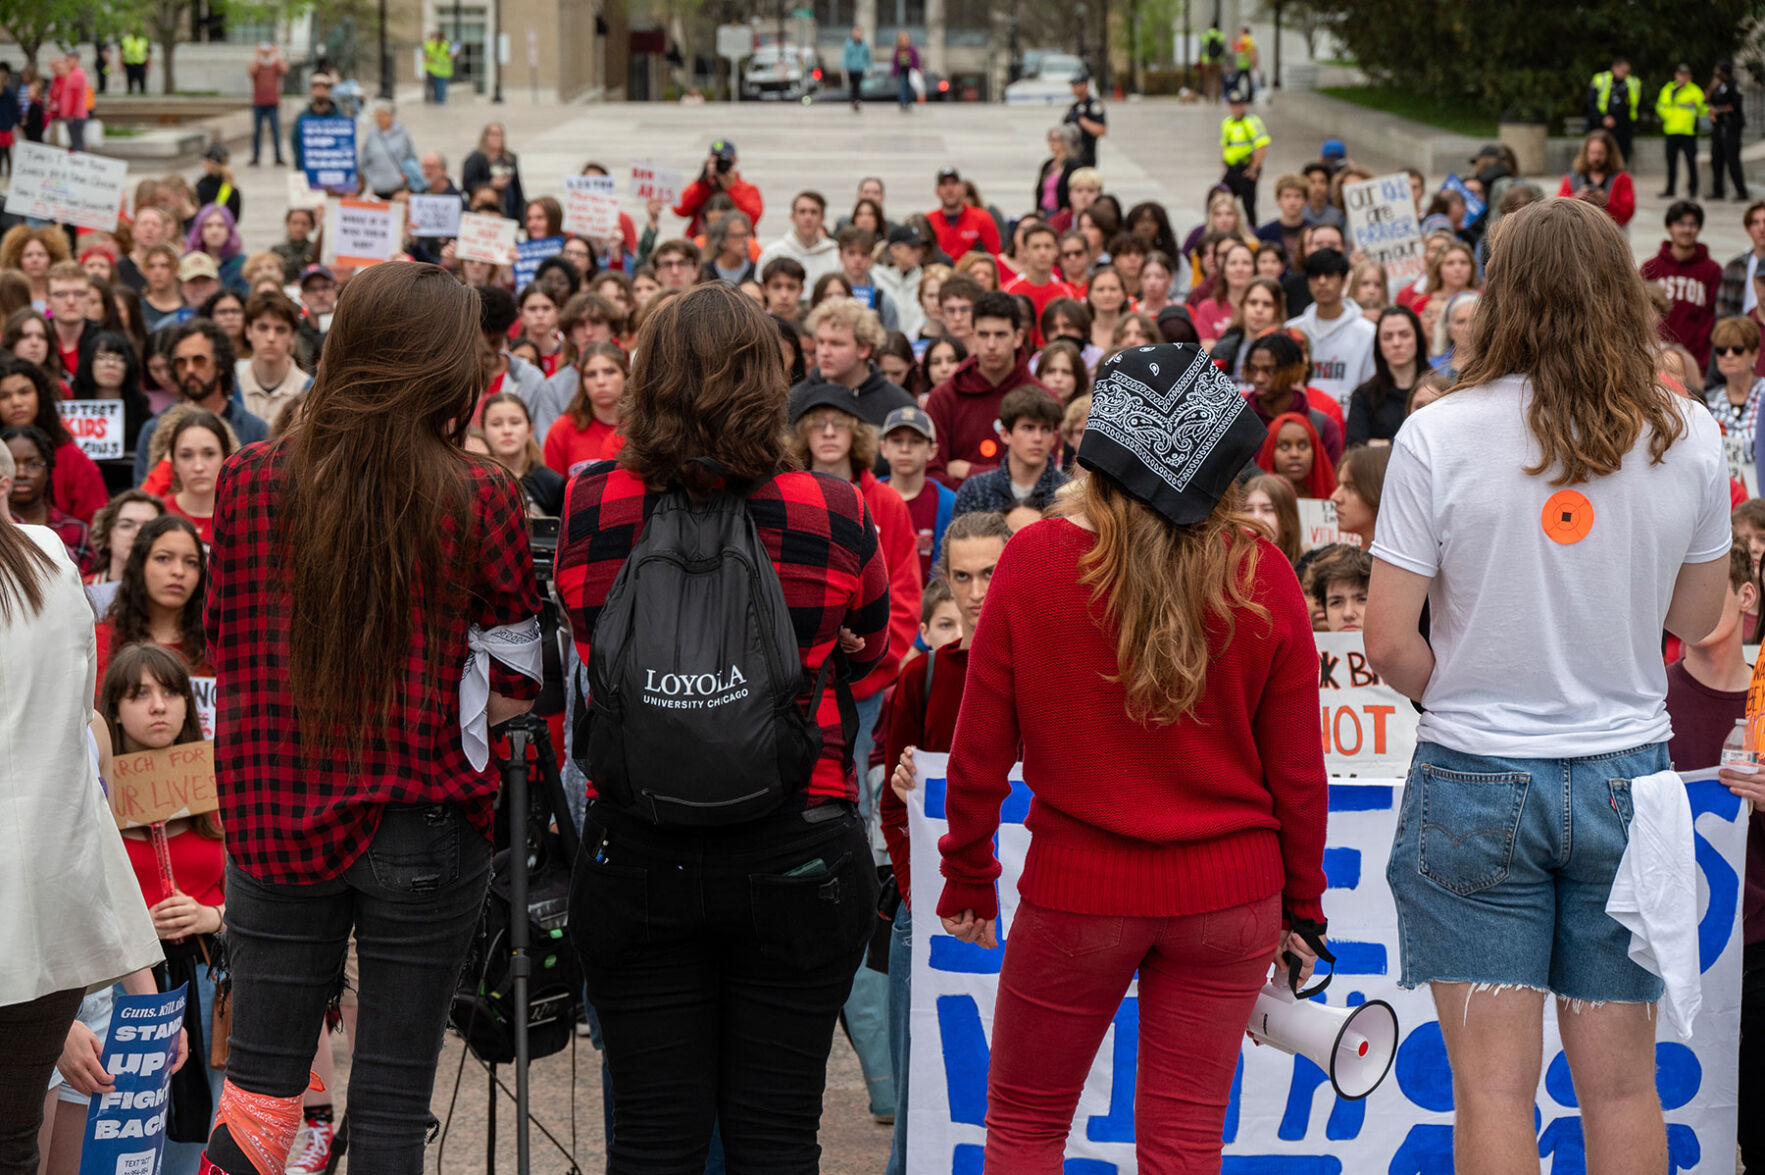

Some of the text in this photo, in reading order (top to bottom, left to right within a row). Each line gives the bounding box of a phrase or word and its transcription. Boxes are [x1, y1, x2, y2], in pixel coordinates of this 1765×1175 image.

[60, 416, 108, 439] KIDS
[644, 664, 747, 696] LOYOLA
[643, 688, 749, 709] UNIVERSITY CHICAGO
[113, 747, 206, 780] RCH FOR
[121, 1007, 157, 1019] Guns.
[115, 1015, 182, 1042] STAND
[107, 1052, 165, 1077] UP
